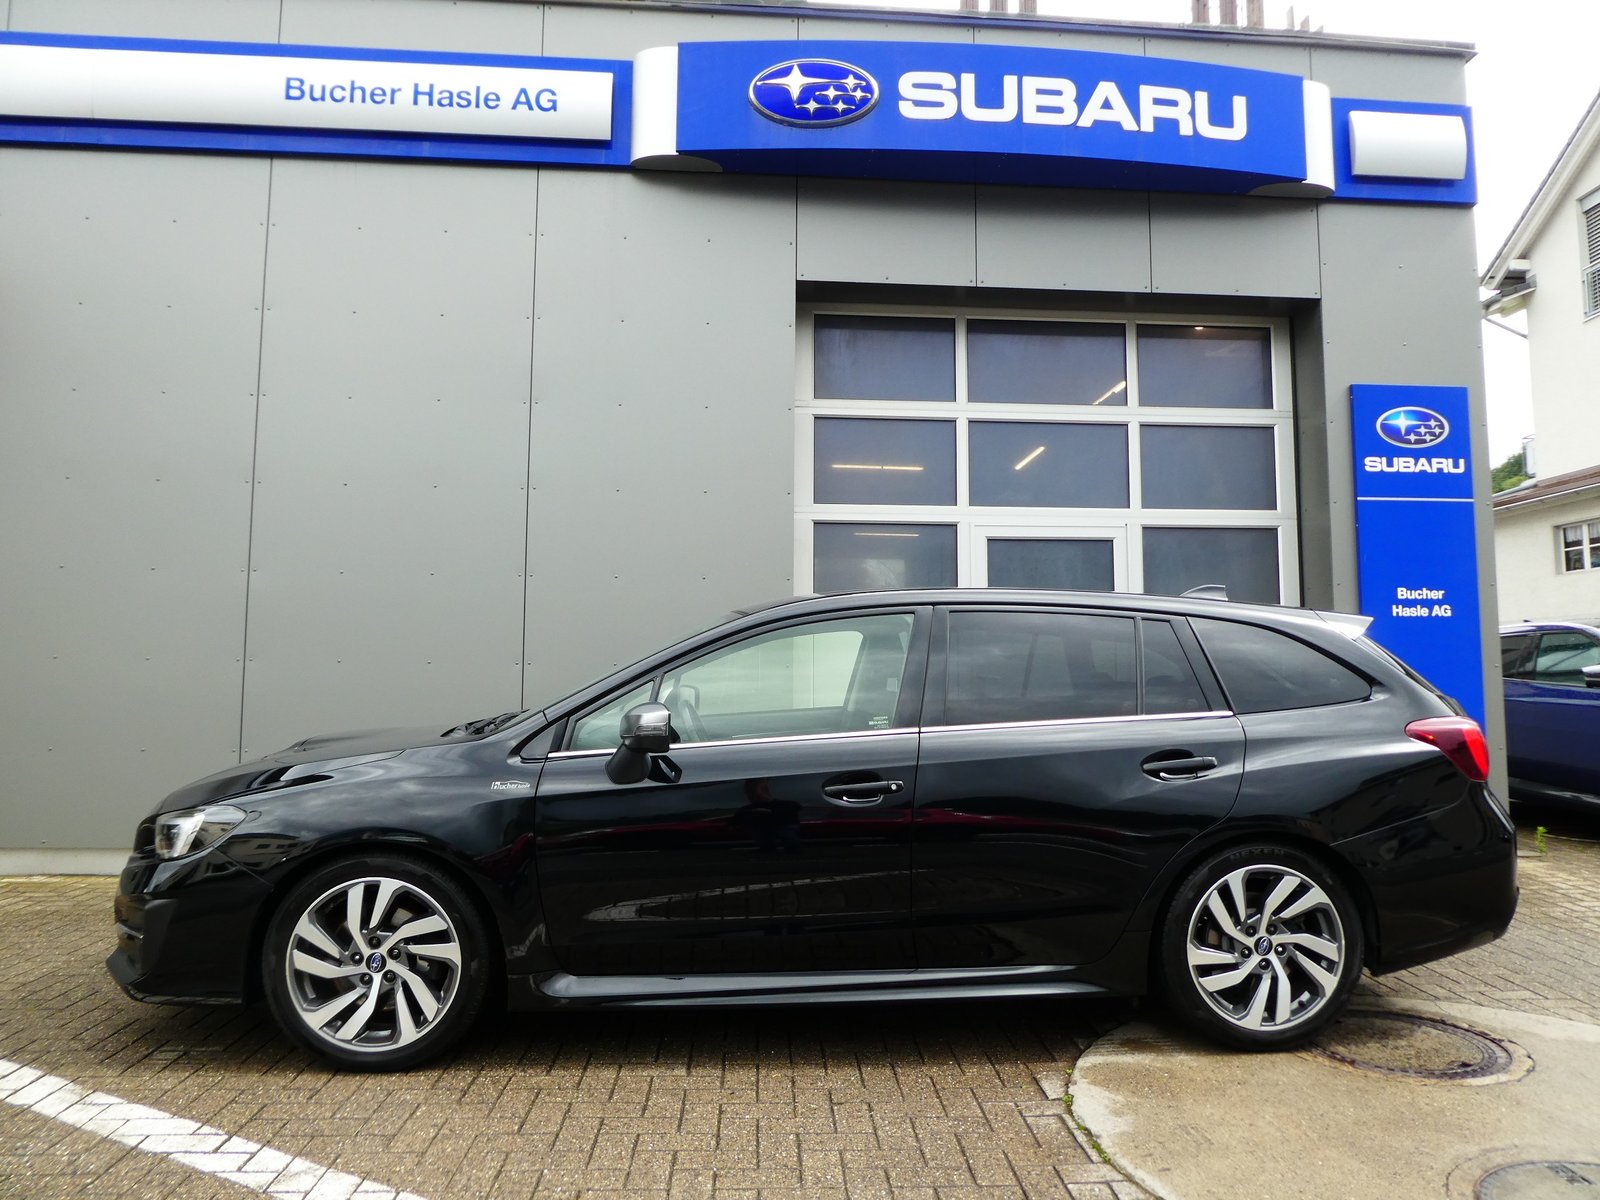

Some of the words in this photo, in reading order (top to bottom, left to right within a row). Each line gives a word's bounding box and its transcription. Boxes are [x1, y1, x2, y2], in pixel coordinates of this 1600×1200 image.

[284, 76, 402, 105] Bucher
[412, 82, 501, 110] Hasle
[511, 87, 558, 113] AG
[897, 70, 1247, 142] SUBARU
[1364, 456, 1465, 473] SUBARU
[1397, 587, 1445, 600] Bucher
[1392, 604, 1430, 617] Hasle
[1432, 604, 1452, 617] AG
